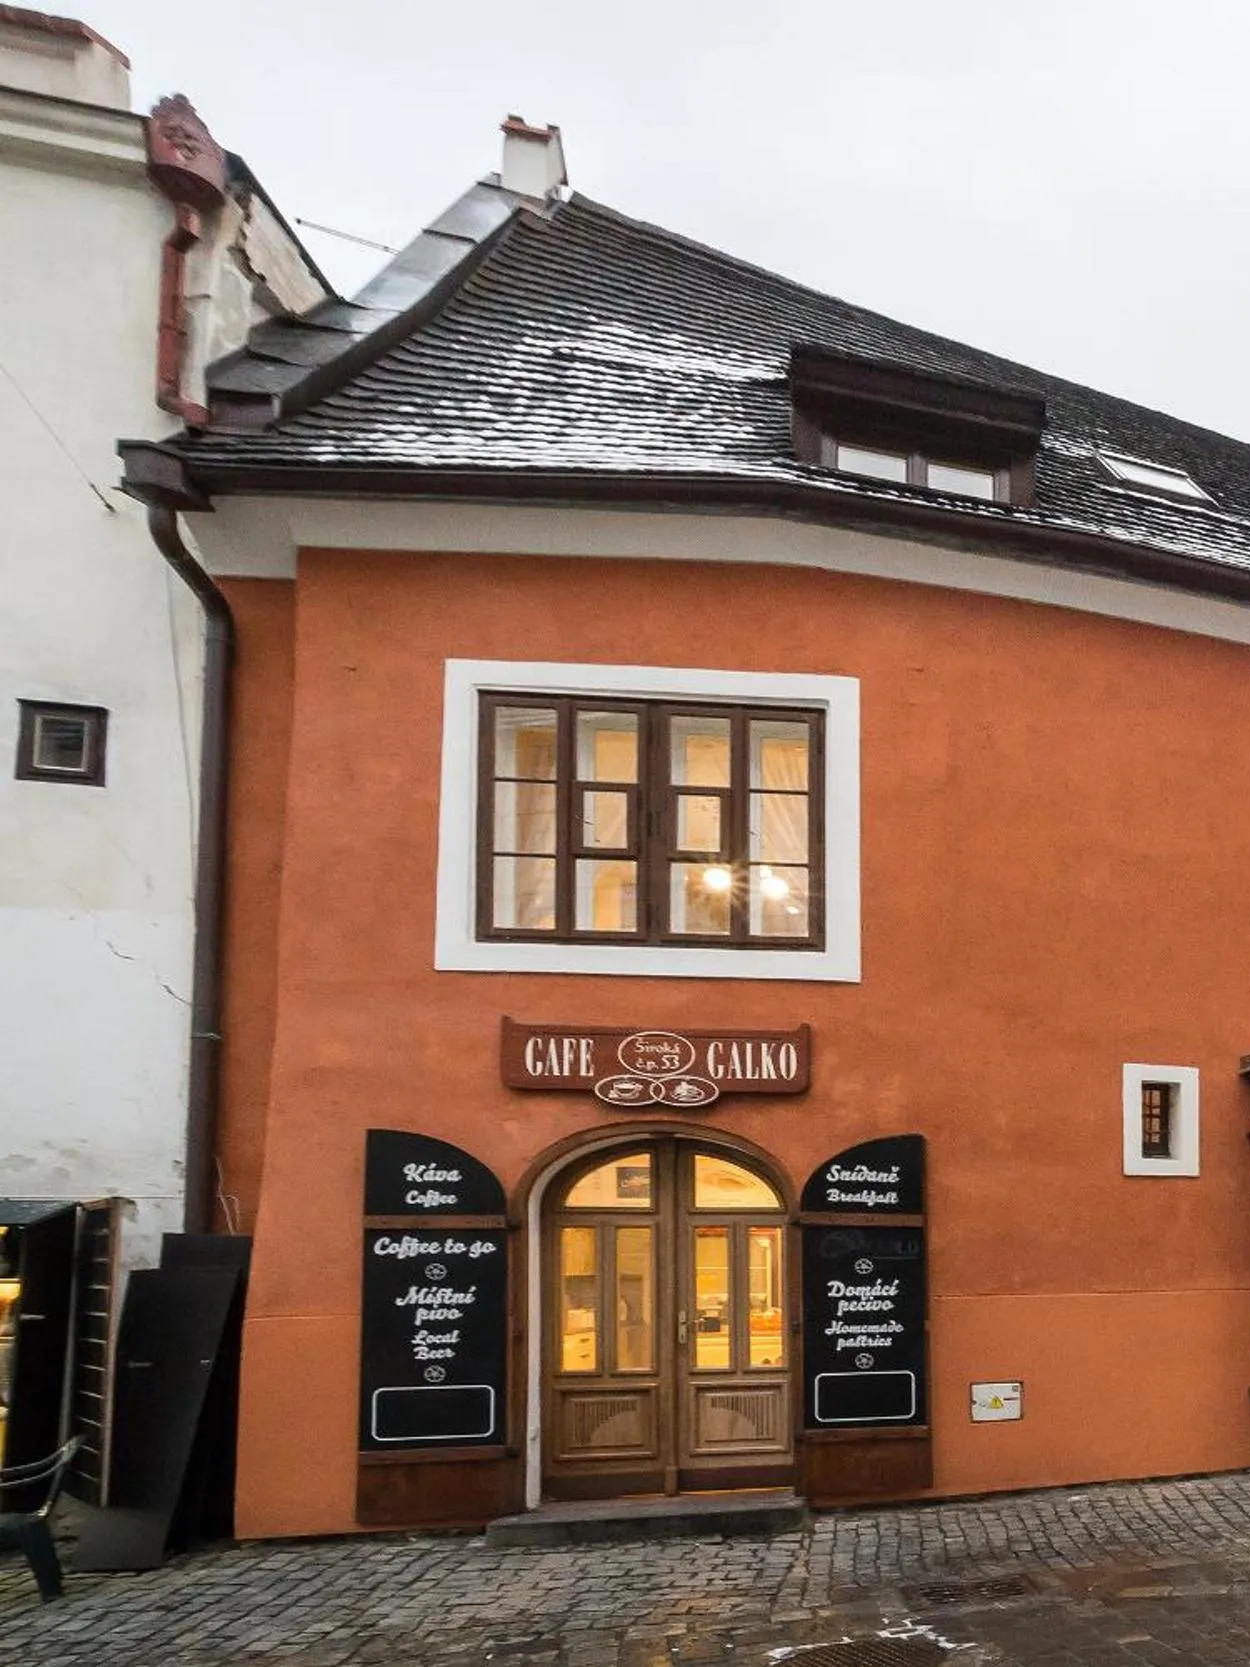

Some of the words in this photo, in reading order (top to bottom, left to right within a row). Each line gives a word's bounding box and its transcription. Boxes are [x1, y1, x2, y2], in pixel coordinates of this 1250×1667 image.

[524, 1037, 595, 1077] CAFE
[706, 1041, 798, 1080] GALKO
[661, 1054, 680, 1070] 53
[403, 1163, 462, 1182] Káva
[826, 1164, 900, 1183] Snídaně
[405, 1189, 458, 1208] Coffee
[826, 1188, 899, 1206] Breakfast
[373, 1235, 442, 1259] Coffee
[444, 1238, 467, 1254] to
[468, 1240, 497, 1258] go
[395, 1285, 477, 1306] Místní
[826, 1278, 900, 1297] Domácí
[414, 1304, 464, 1326] pivo
[836, 1295, 896, 1316] pečivo
[411, 1329, 461, 1345] Local
[824, 1320, 904, 1336] Homemade
[836, 1335, 893, 1351] pastries
[413, 1346, 456, 1361] Beer
